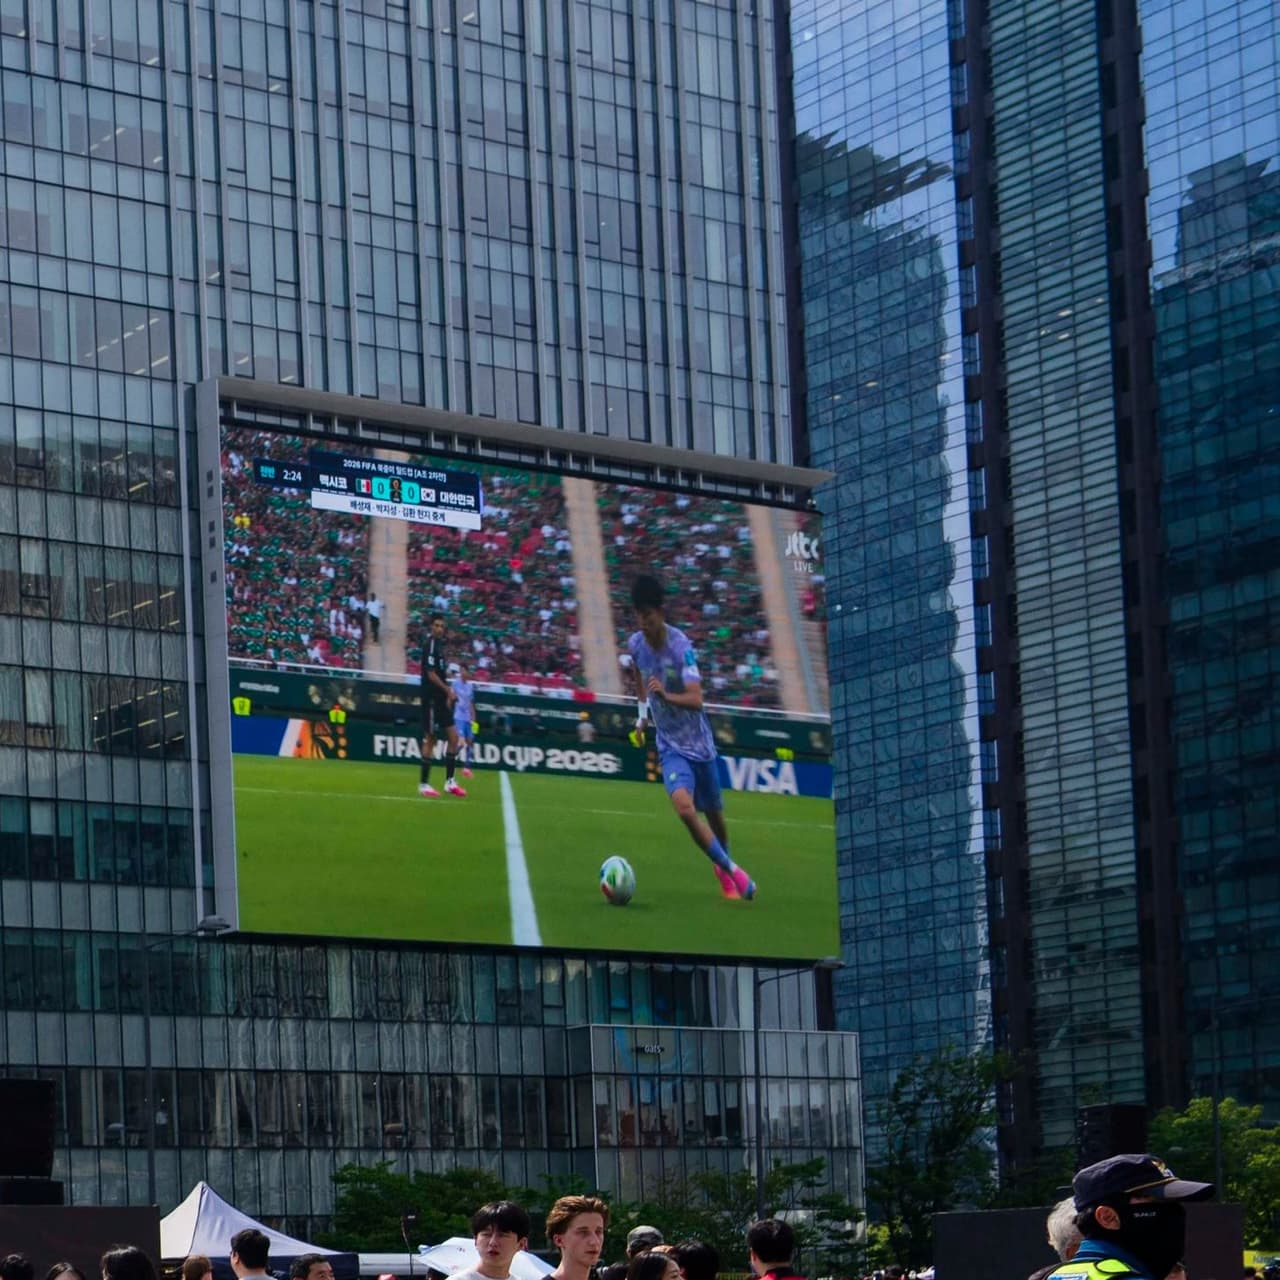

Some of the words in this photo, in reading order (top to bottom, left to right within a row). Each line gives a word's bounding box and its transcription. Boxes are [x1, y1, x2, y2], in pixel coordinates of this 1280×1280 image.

[282, 469, 302, 482] 2:24
[794, 560, 814, 573] LIVE
[373, 734, 423, 760] FIFA
[502, 744, 545, 767] CUP
[546, 747, 622, 774] 2026
[721, 755, 799, 796] VISA
